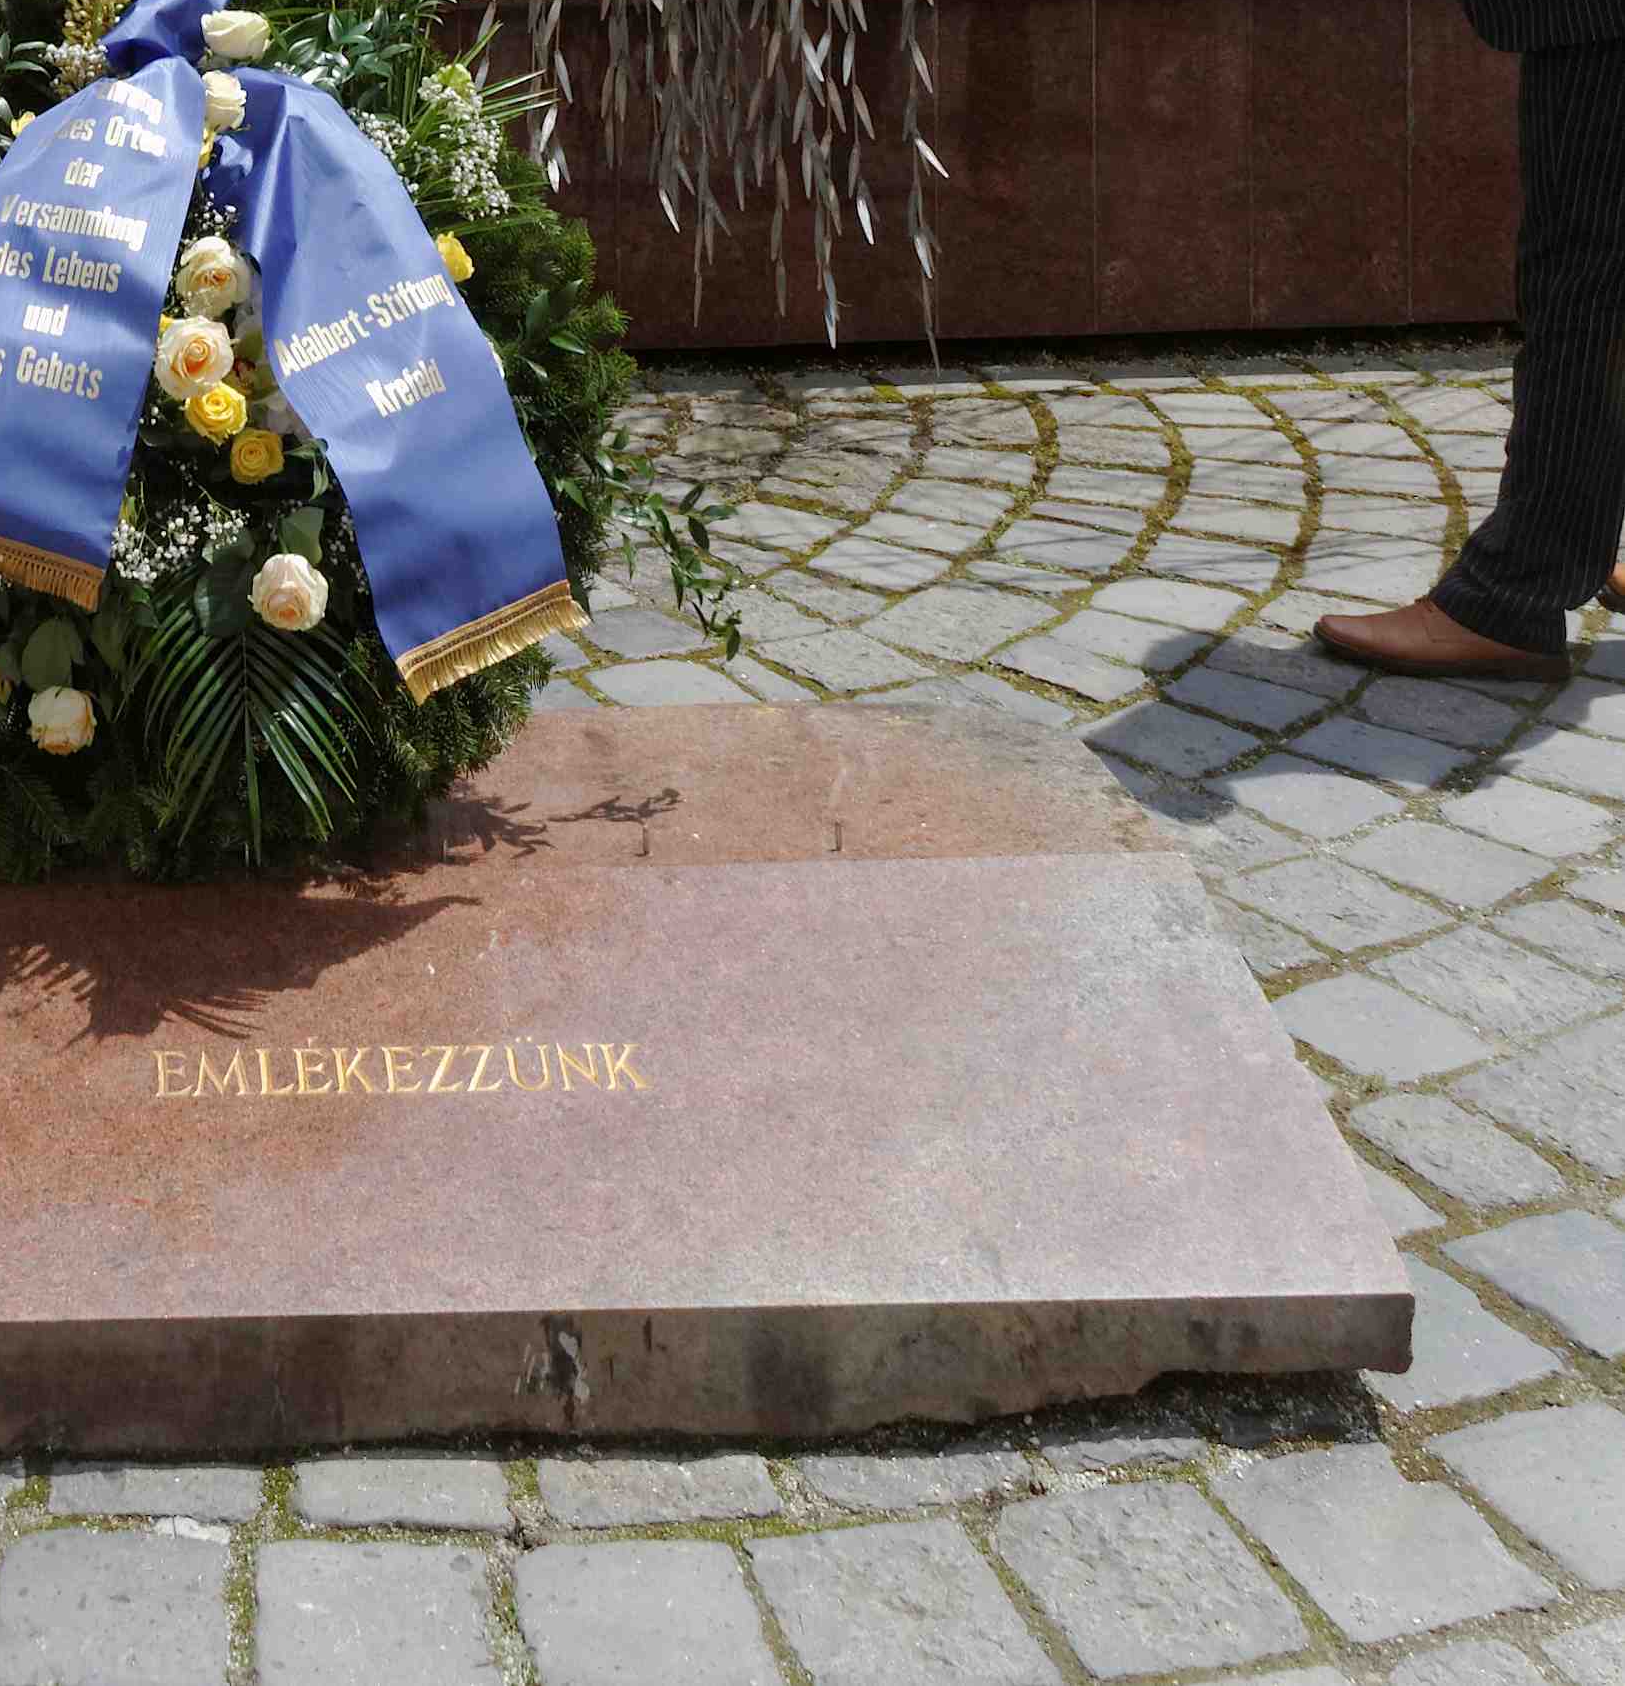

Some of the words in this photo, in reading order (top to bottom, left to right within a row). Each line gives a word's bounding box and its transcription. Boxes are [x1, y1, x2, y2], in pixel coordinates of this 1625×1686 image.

[63, 158, 104, 188] der
[0, 194, 148, 252] Versammlung
[42, 245, 122, 293] Lebens
[22, 303, 70, 336] und
[274, 273, 455, 377] Adalbert-Stiftung
[16, 346, 103, 400] Gebets
[365, 358, 447, 418] Krefeld
[153, 1035, 653, 1098] EMLÉKEZZÜNK
